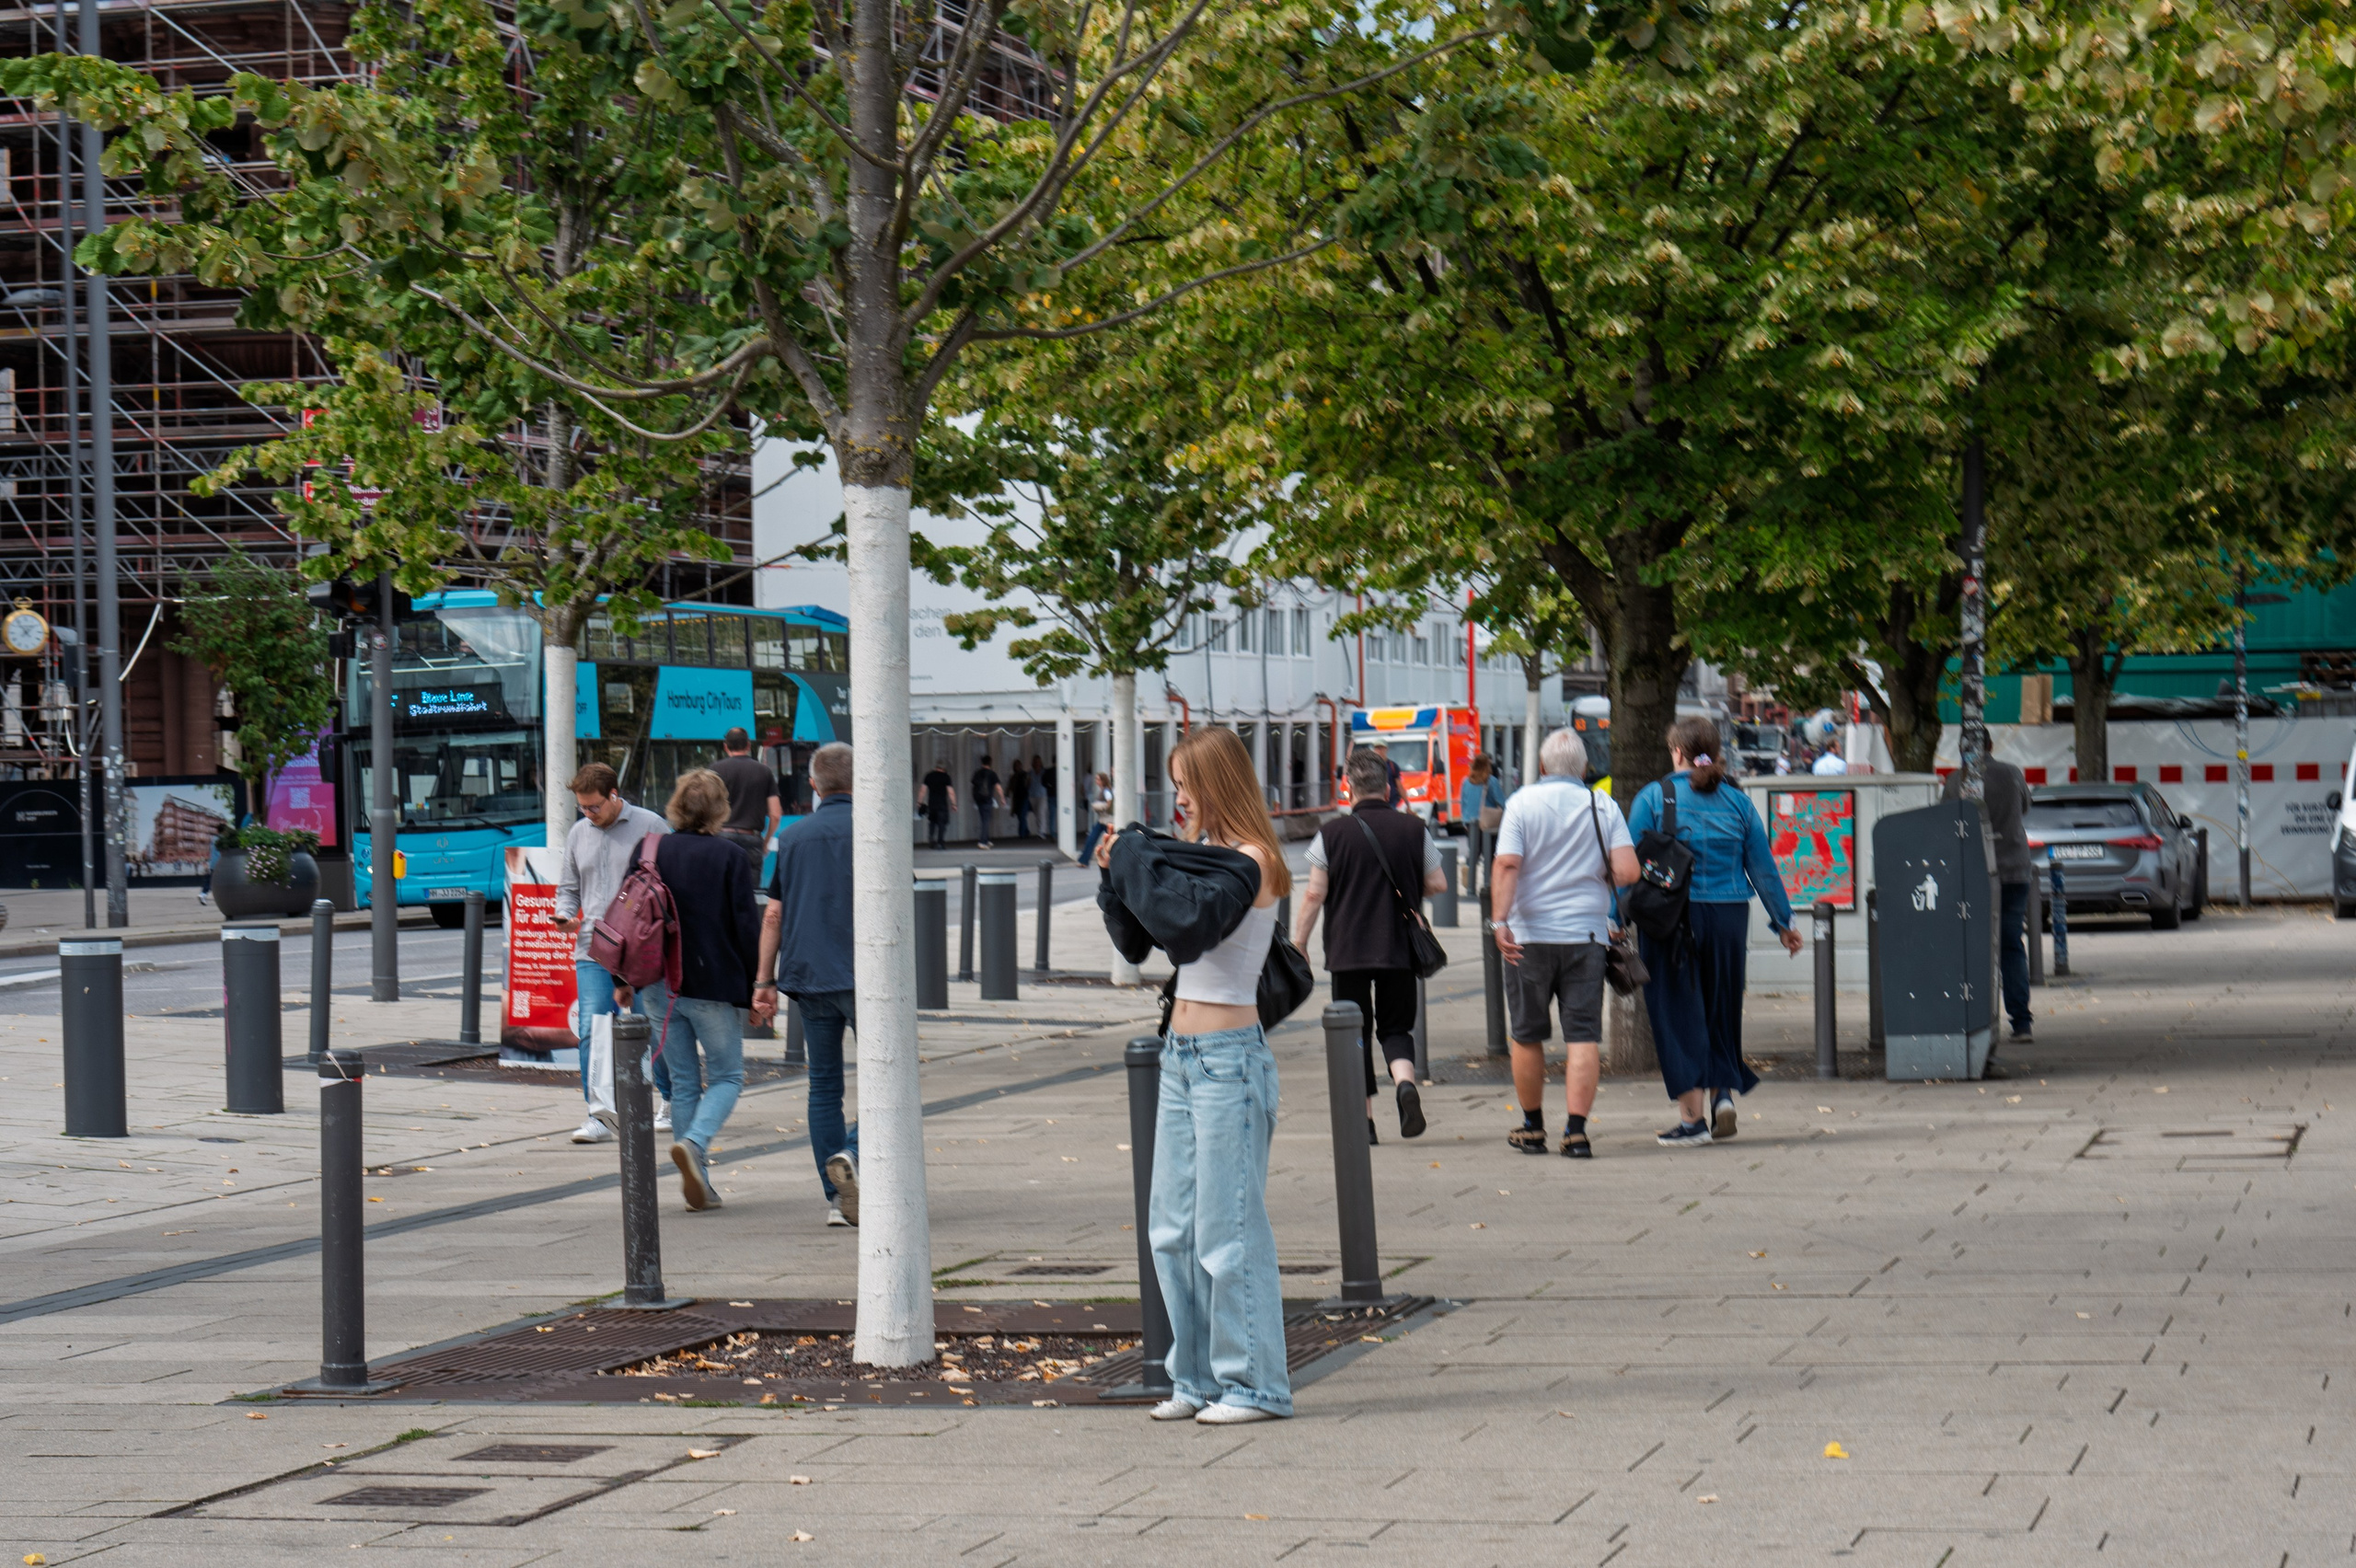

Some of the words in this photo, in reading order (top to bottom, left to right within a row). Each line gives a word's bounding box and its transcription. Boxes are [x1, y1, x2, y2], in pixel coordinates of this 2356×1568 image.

[914, 624, 941, 638] den
[666, 689, 705, 716] Hamburg
[514, 908, 530, 924] für
[514, 928, 548, 940] Hamburgs
[548, 929, 567, 941] Weg
[514, 939, 525, 948] die
[525, 940, 572, 950] medizinische
[514, 949, 551, 961] Versorgung
[551, 950, 568, 960] der
